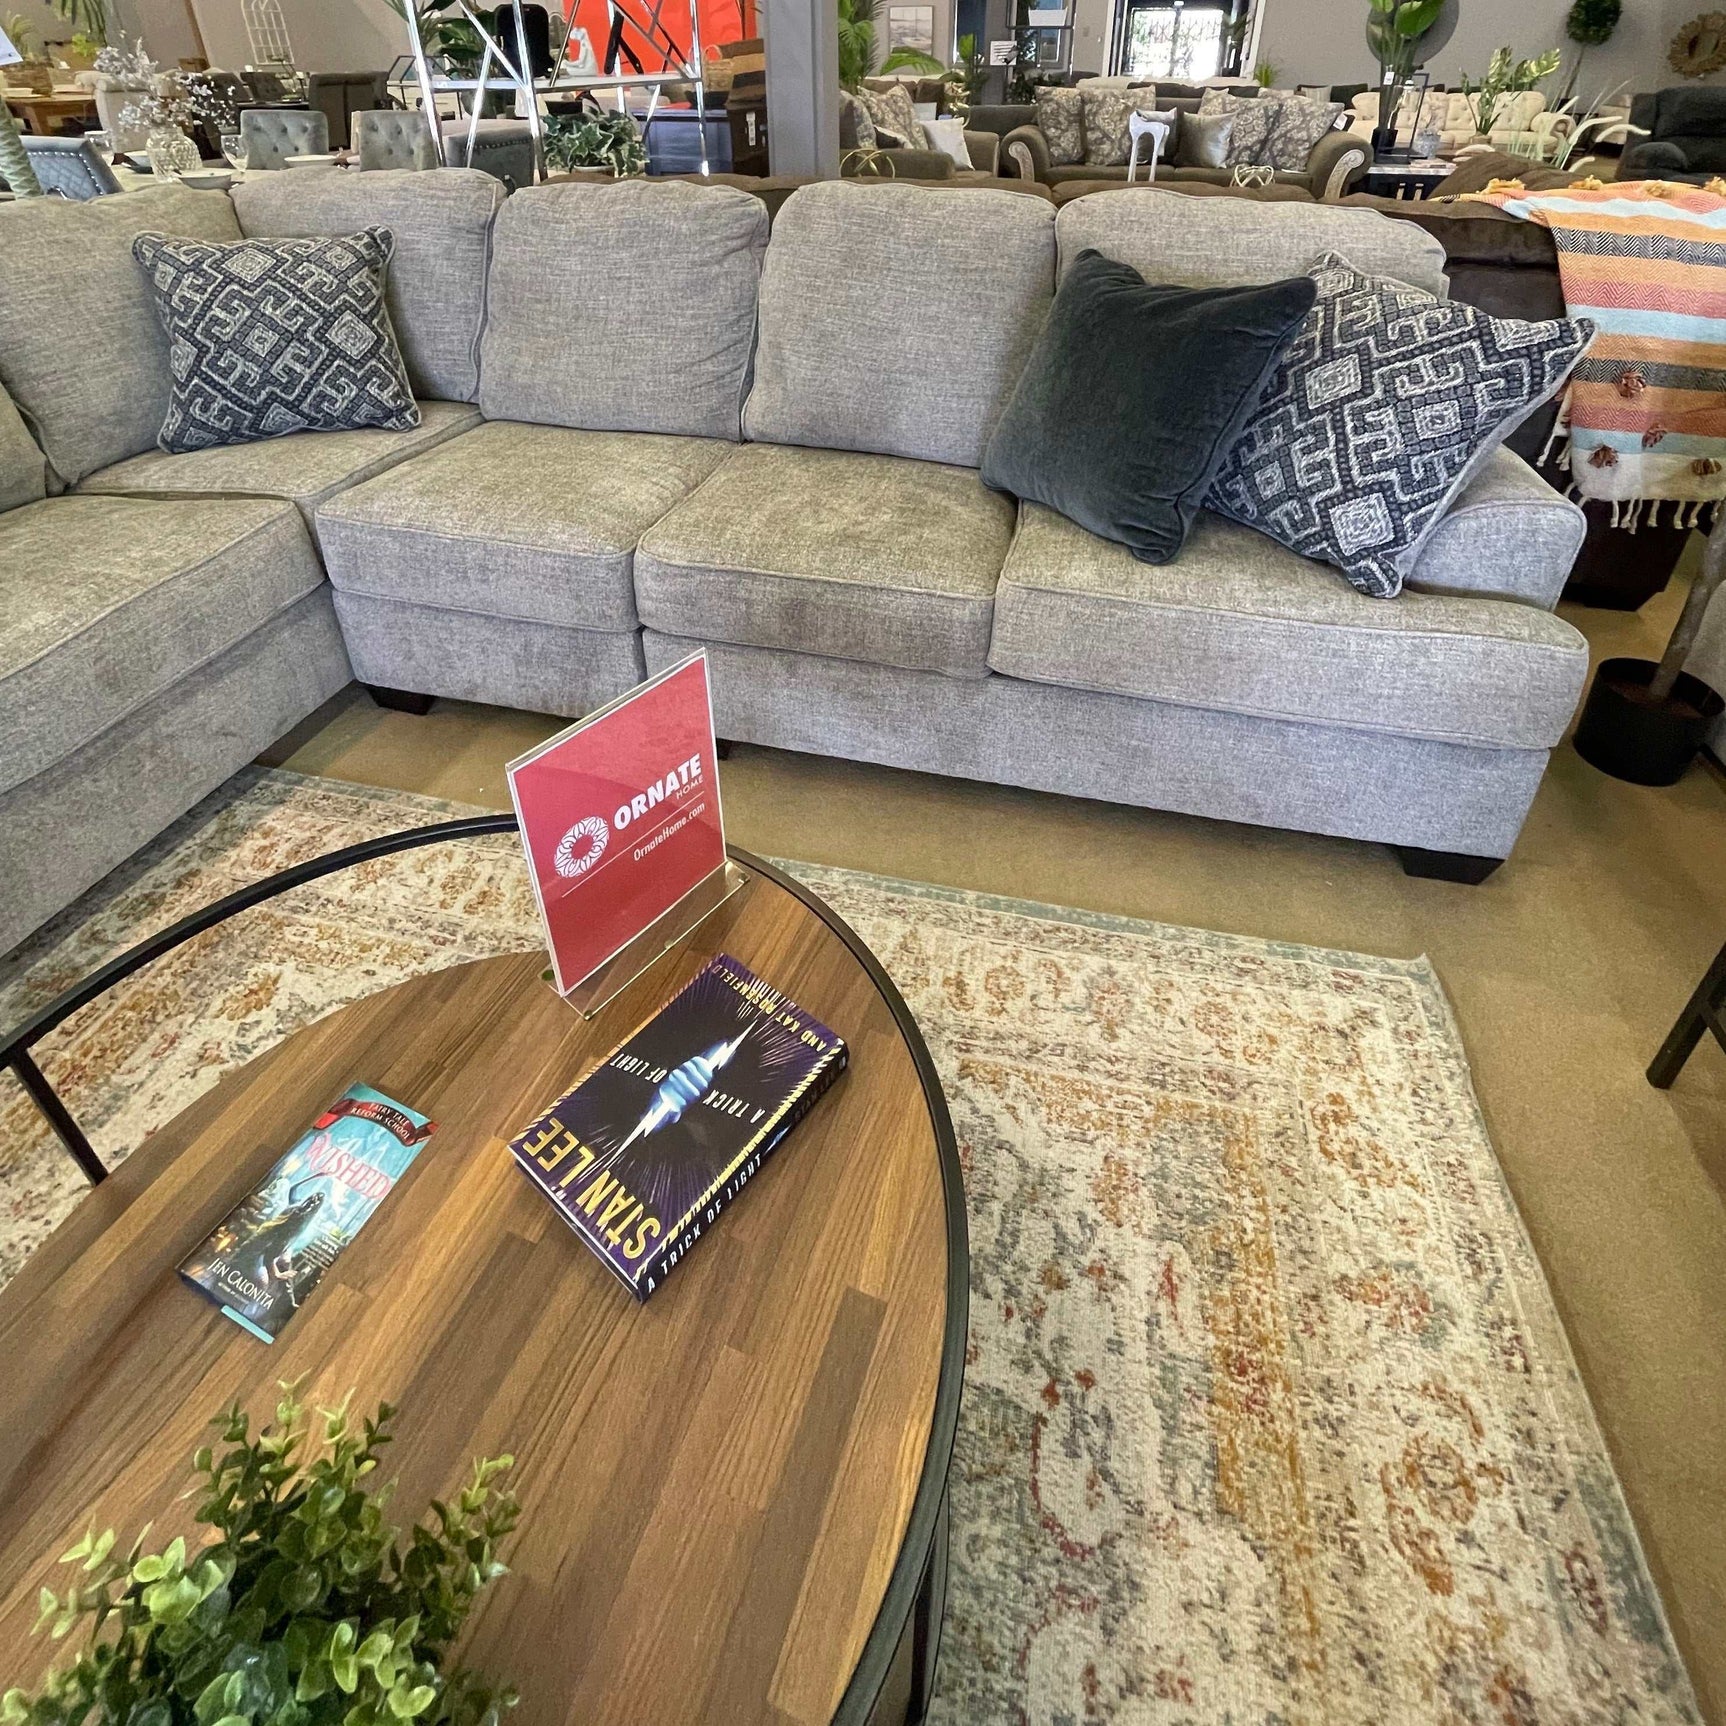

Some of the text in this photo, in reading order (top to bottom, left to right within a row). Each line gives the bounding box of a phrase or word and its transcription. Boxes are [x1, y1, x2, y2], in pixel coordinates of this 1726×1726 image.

[613, 753, 702, 830] ORNATE
[676, 775, 704, 800] HOME
[633, 802, 706, 862] OrnateHome.com
[712, 964, 827, 1052] AND KAT ROSENFIELD
[609, 1053, 668, 1083] OF LIGHT
[350, 1107, 410, 1139] REFORM SCHOOL
[368, 1103, 410, 1126] FAIRY TALE
[703, 1089, 765, 1124] A TRICK
[522, 1117, 661, 1259] STAN LEE
[647, 1153, 761, 1293] A TRICK OF LIGHT
[207, 1257, 230, 1277] JEN
[227, 1270, 274, 1310] CALONITA
